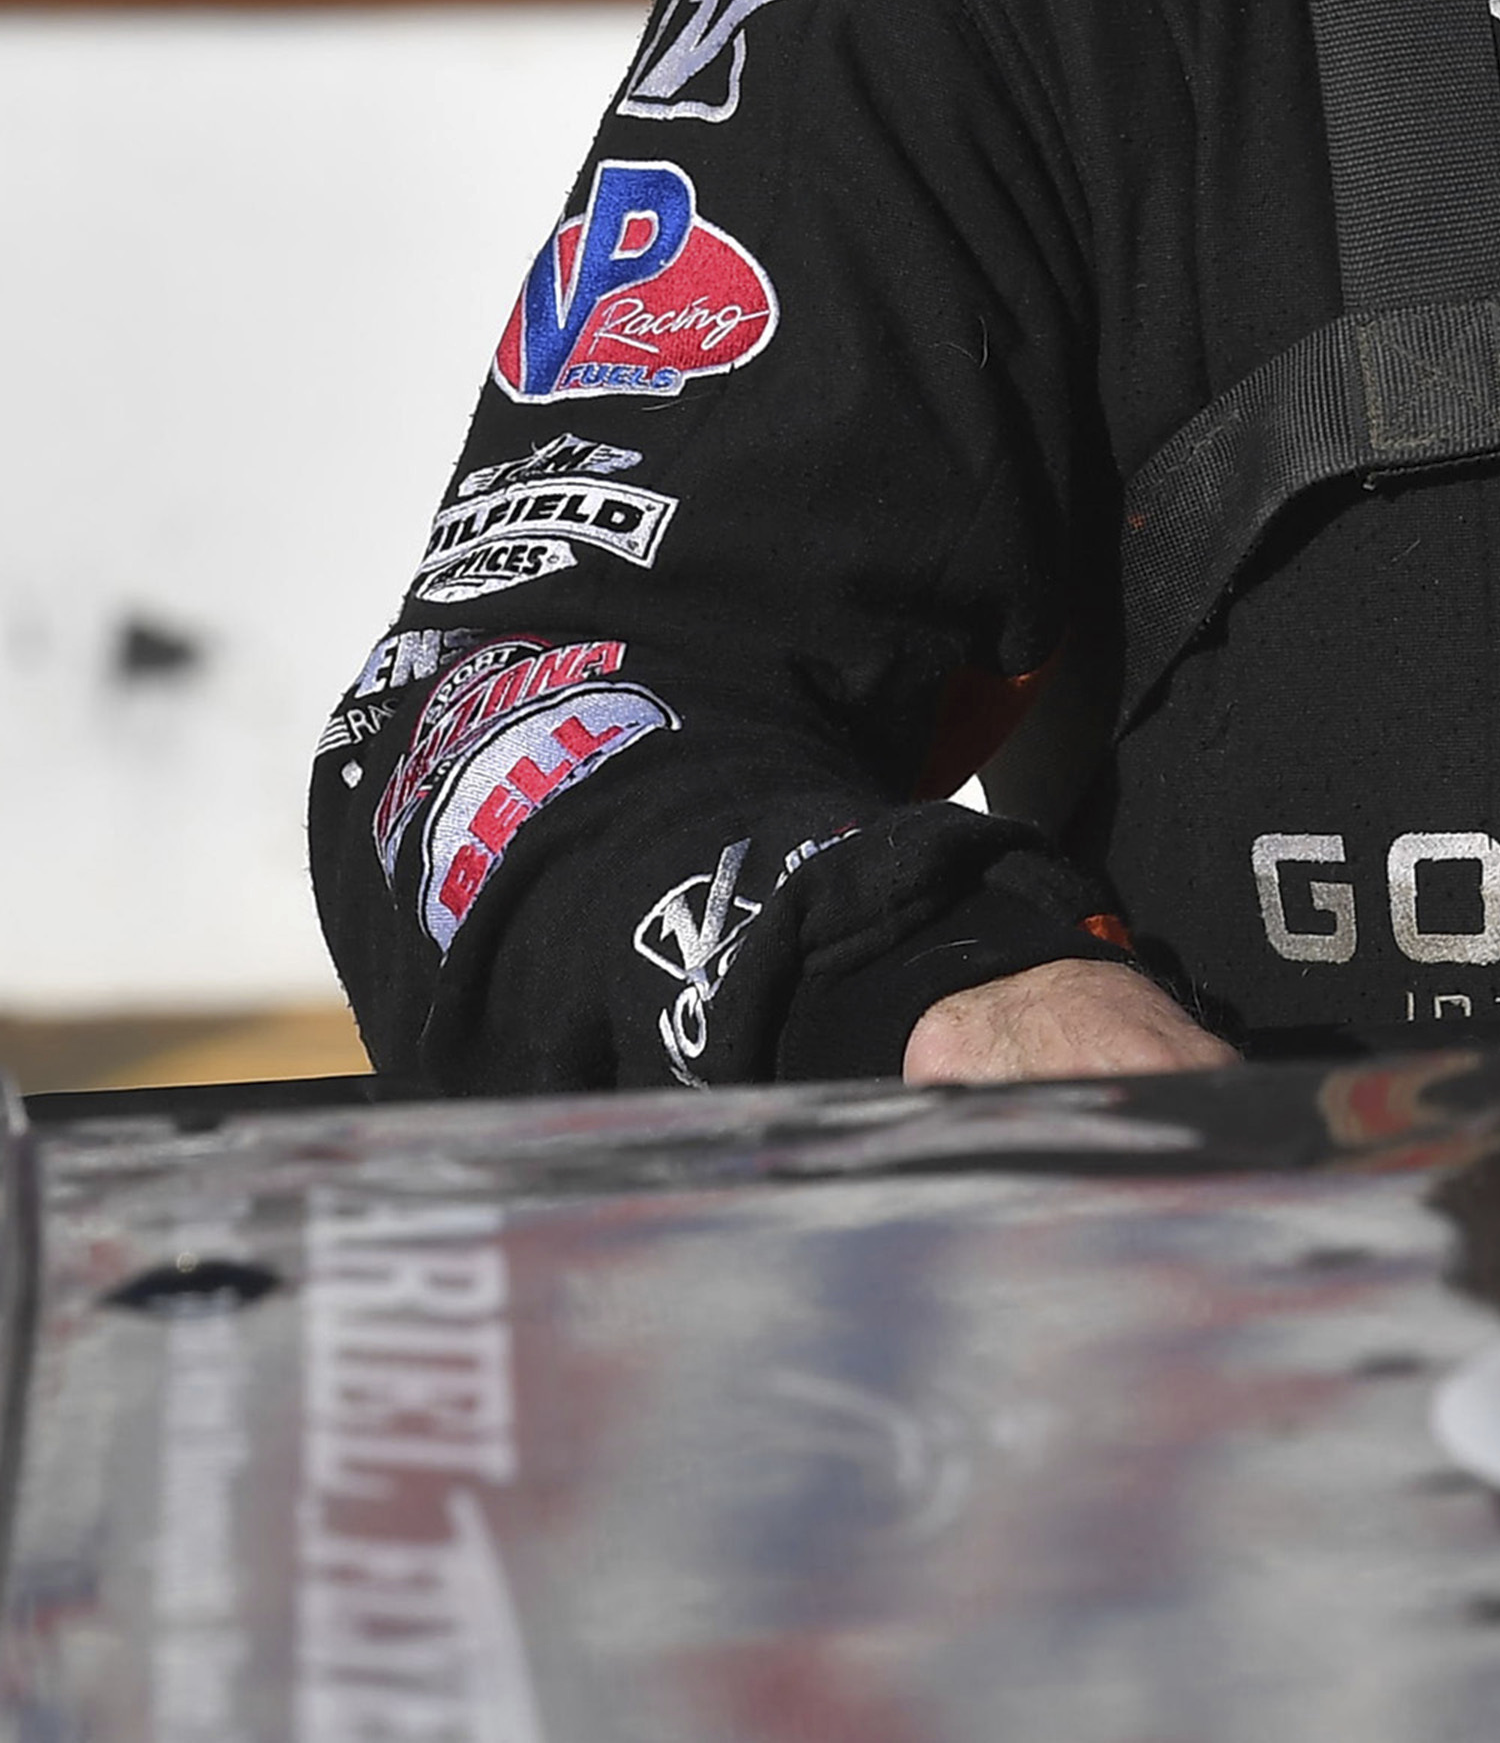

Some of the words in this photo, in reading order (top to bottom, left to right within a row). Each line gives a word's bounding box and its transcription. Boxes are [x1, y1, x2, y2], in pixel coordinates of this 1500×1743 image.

[521, 159, 696, 397] VP
[587, 295, 770, 354] Racing
[561, 362, 683, 392] FUELS
[426, 646, 518, 726] SPORT
[439, 715, 624, 920] BELL
